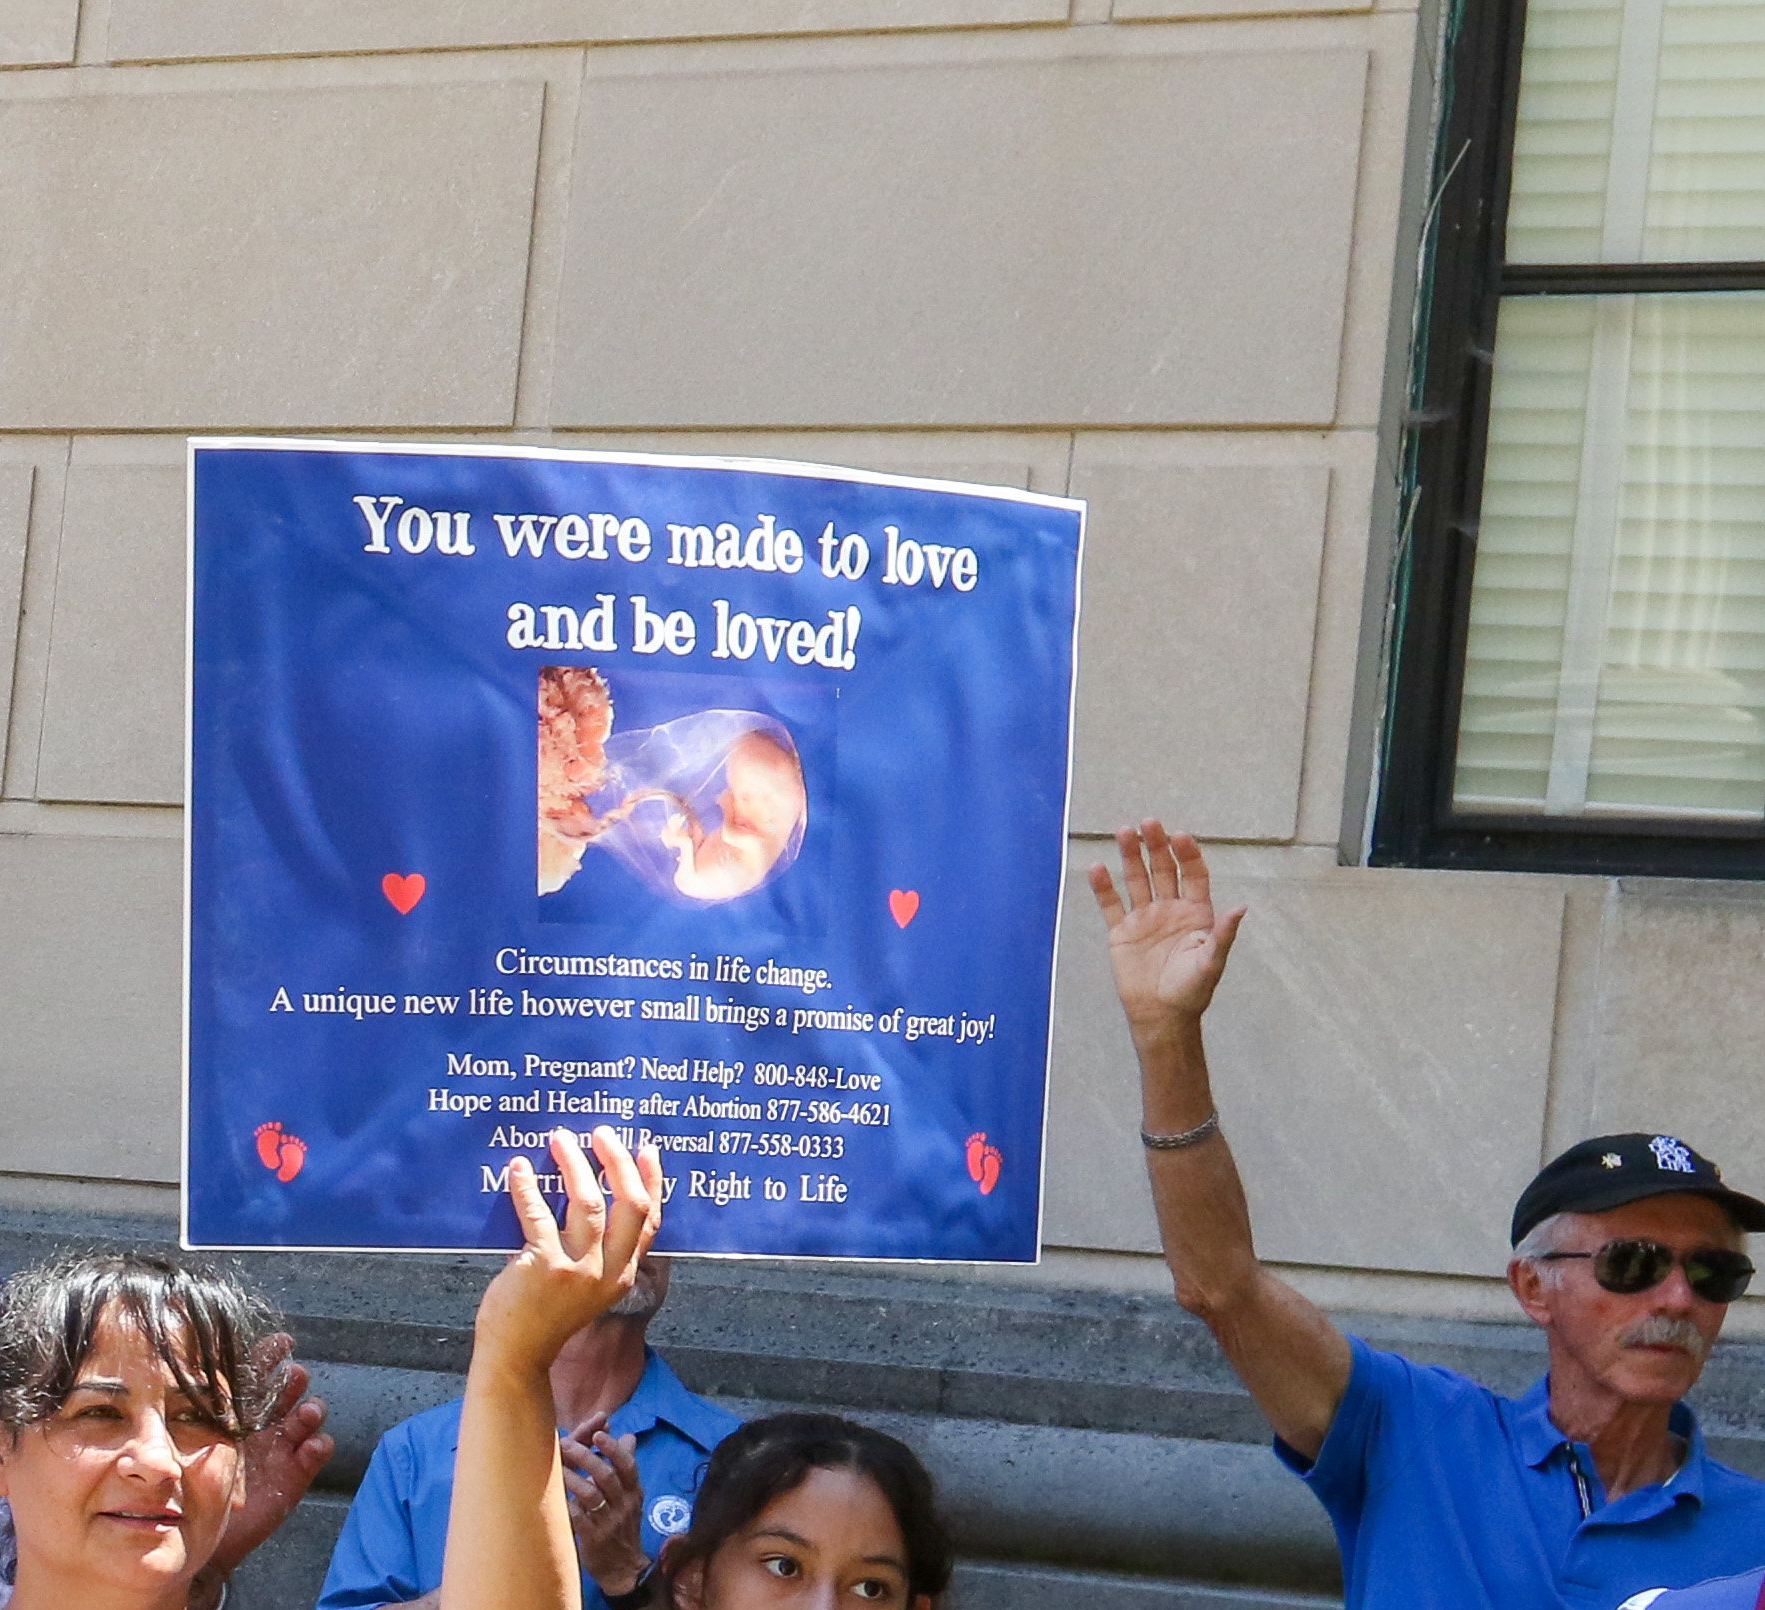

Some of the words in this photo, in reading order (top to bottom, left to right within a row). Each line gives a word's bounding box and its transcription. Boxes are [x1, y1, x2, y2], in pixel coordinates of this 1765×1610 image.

[352, 495, 476, 556] You
[492, 513, 652, 563] were
[665, 513, 804, 575] made
[817, 521, 870, 582] to
[881, 525, 978, 592] love
[506, 593, 618, 652] and
[629, 596, 696, 656] be
[711, 599, 862, 671] loved!
[495, 947, 684, 980] Circumstances
[688, 953, 709, 981] in
[714, 955, 751, 984] life
[755, 958, 832, 995] change.
[269, 986, 295, 1012] A
[302, 986, 397, 1021] unique
[403, 995, 460, 1014] new
[469, 988, 514, 1016] life
[521, 989, 636, 1018] however
[640, 994, 700, 1022] small
[705, 995, 770, 1032] brings
[775, 1008, 788, 1027] a
[791, 1004, 874, 1035] promise
[878, 1007, 905, 1033] of
[904, 1014, 956, 1041] great
[955, 1011, 995, 1045] joy!
[446, 1053, 517, 1081] Mom,
[524, 1054, 636, 1084] Pregnant?
[640, 1057, 689, 1082] Need
[691, 1059, 745, 1090] Help?
[753, 1062, 882, 1092] 800-848-Love
[428, 1088, 492, 1118] Hope
[498, 1089, 540, 1113] and
[547, 1090, 635, 1121] Healing
[638, 1092, 681, 1116] after
[682, 1094, 762, 1120] Abortion
[766, 1098, 890, 1126] 877-586-4621
[488, 1125, 592, 1148] Aborton
[718, 1131, 844, 1159] 877-558-0333
[687, 1170, 752, 1206] Right
[763, 1176, 787, 1201] to
[799, 1174, 848, 1203] Life
